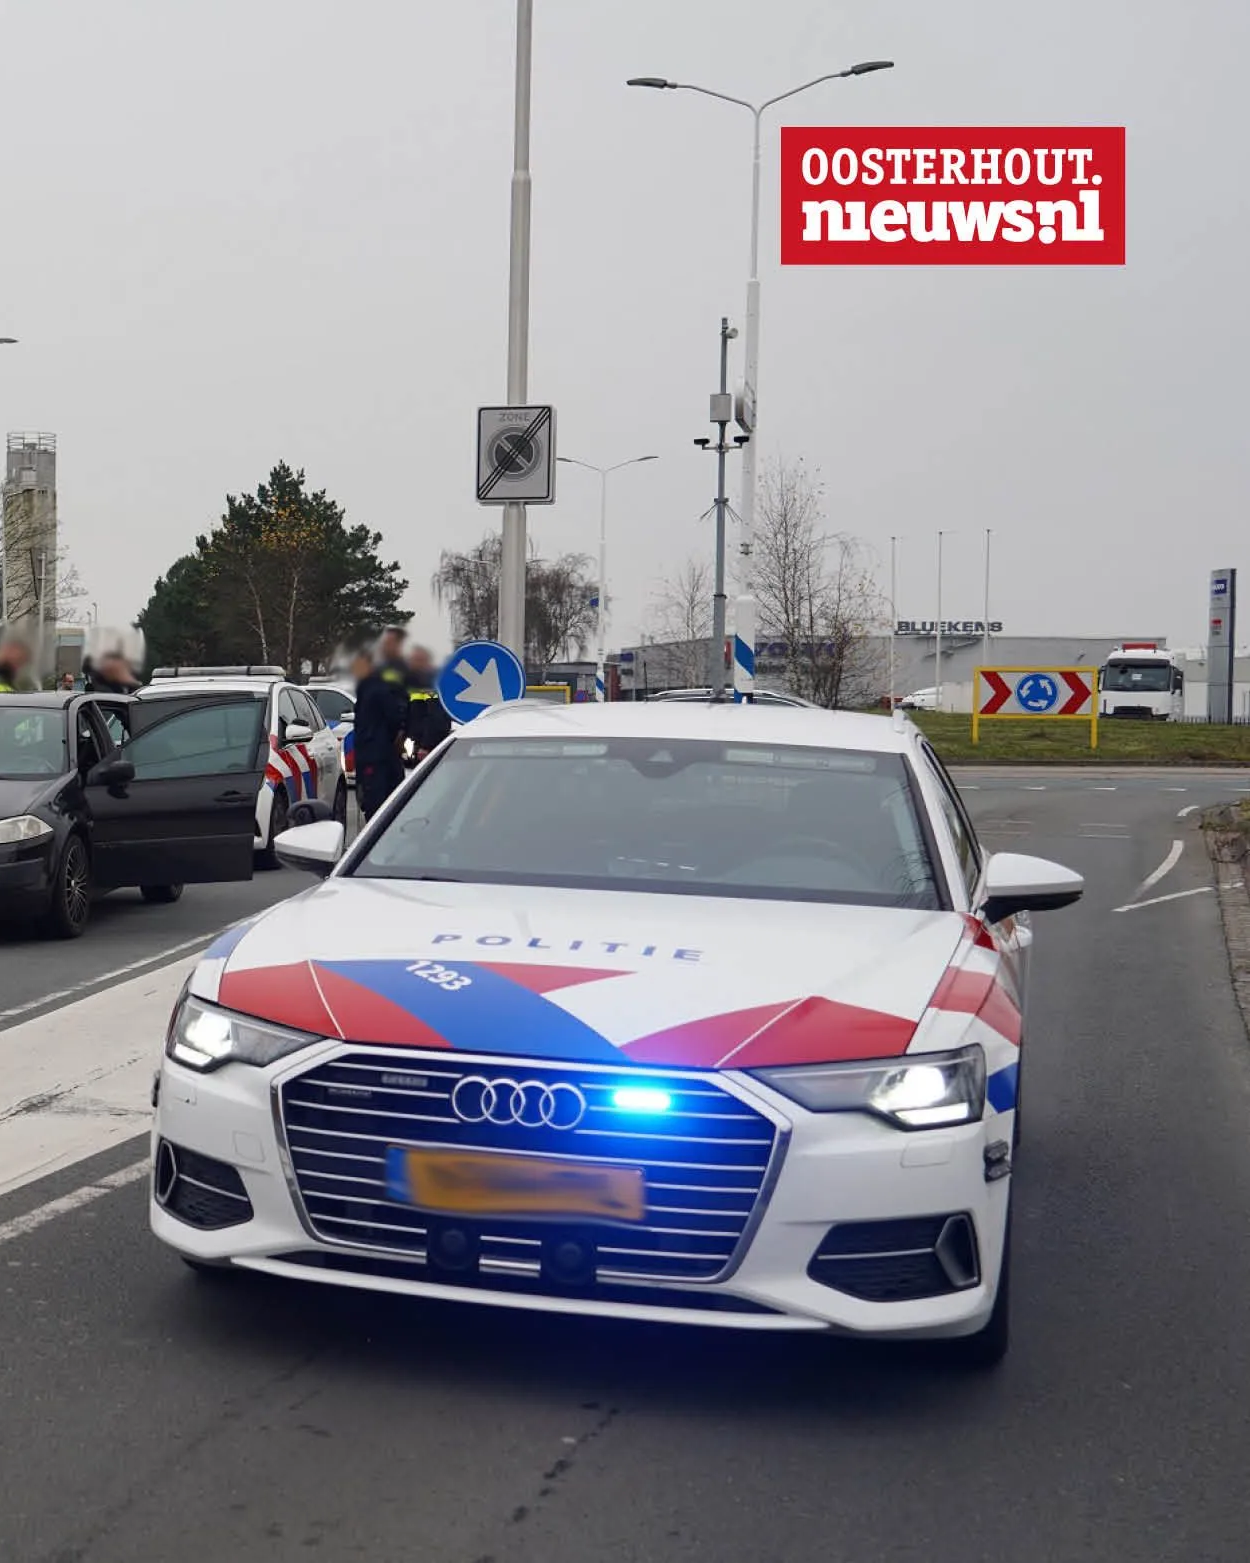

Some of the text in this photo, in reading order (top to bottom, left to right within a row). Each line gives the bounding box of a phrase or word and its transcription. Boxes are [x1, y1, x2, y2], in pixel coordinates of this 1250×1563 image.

[499, 412, 530, 422] ZONE
[897, 621, 1003, 632] BLUEKENS
[431, 934, 704, 962] POLITIE
[405, 960, 472, 991] 1293
